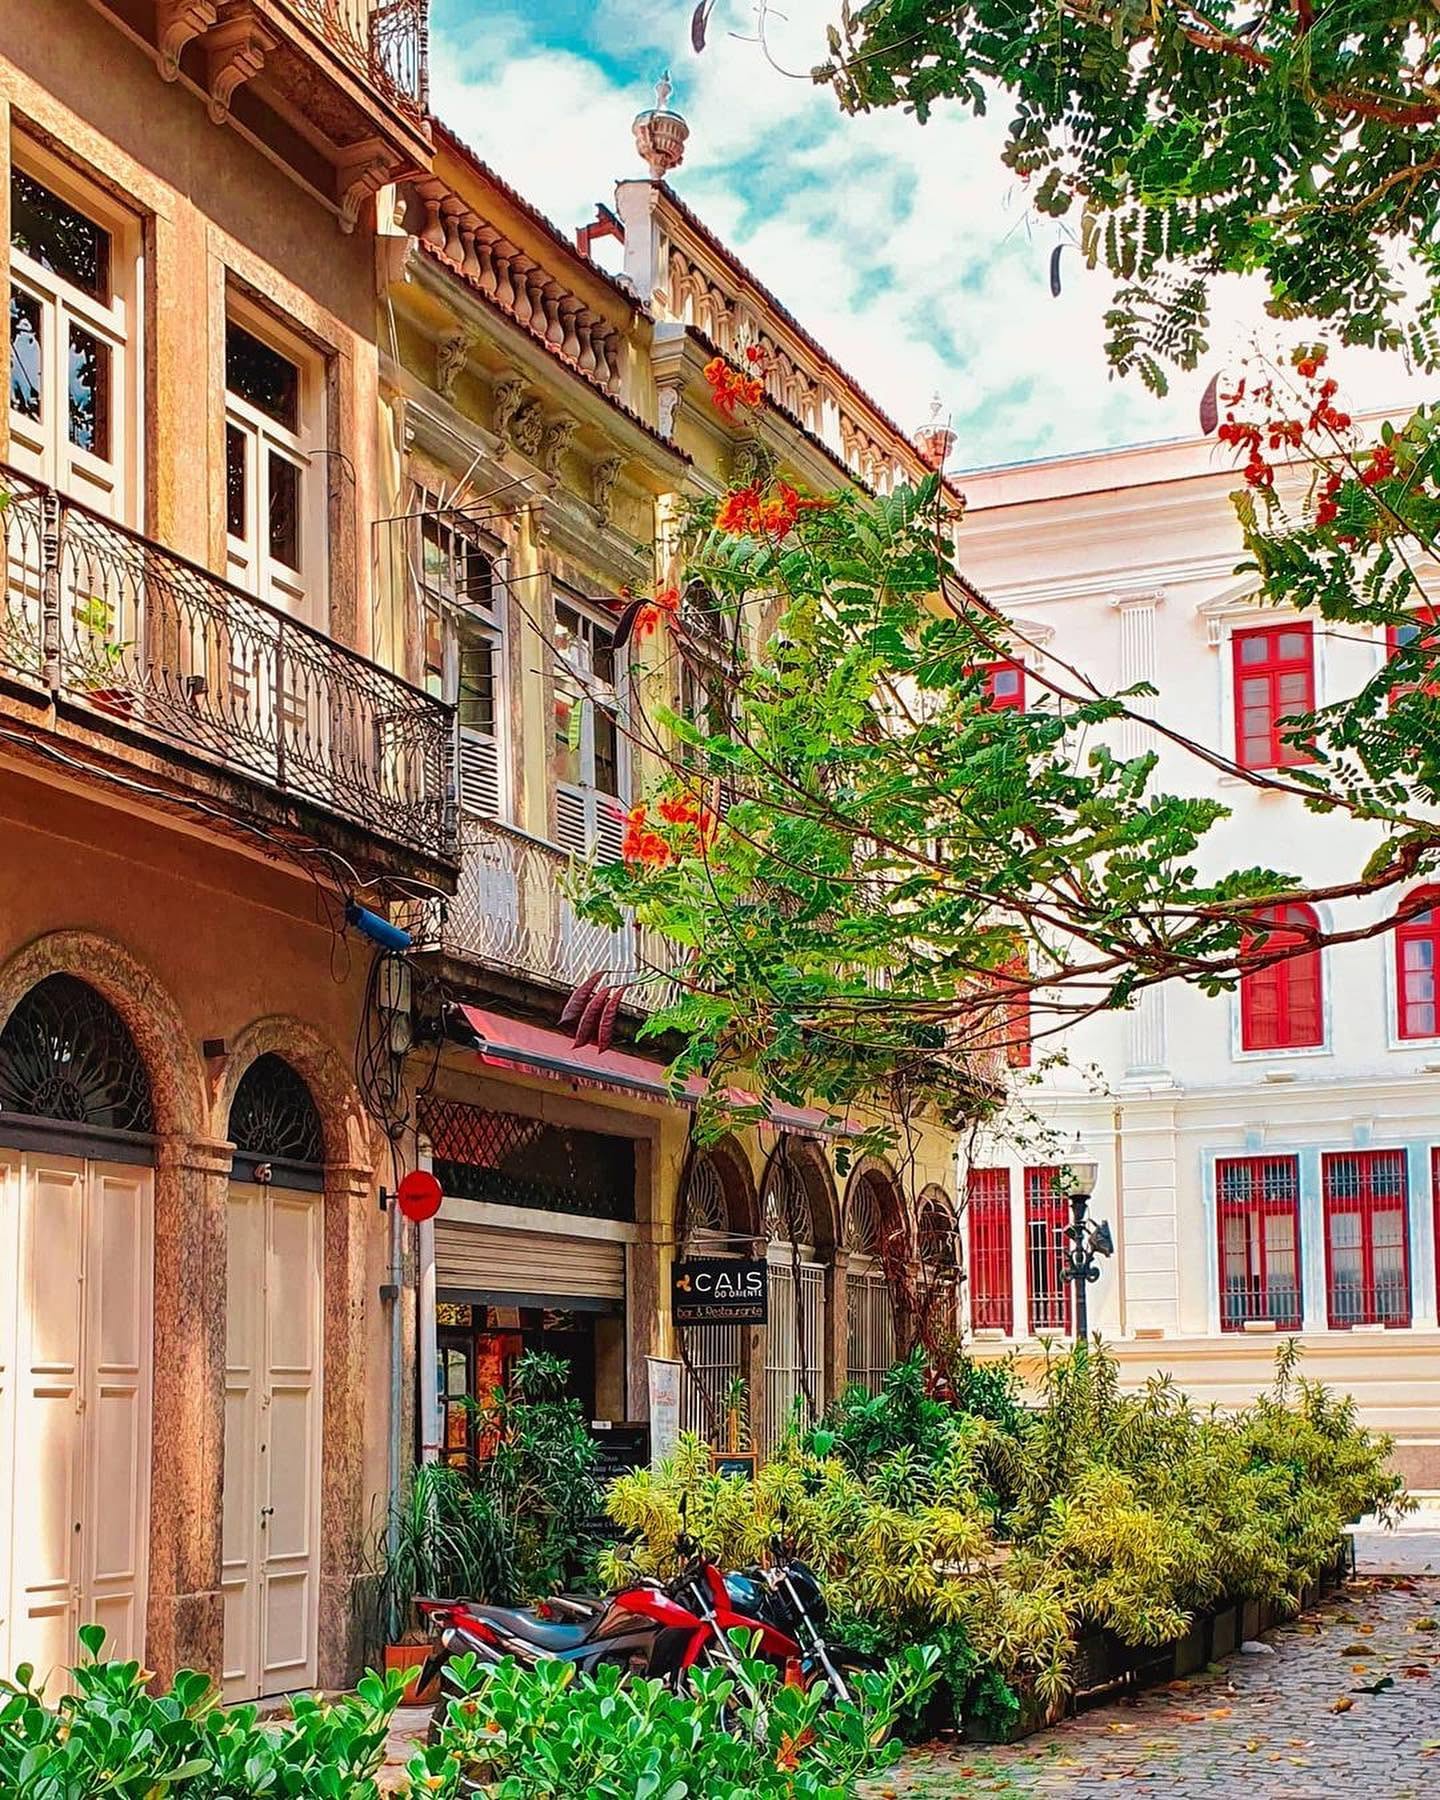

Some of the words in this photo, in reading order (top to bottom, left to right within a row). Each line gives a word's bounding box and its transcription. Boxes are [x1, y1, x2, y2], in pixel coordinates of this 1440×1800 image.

[695, 1271, 763, 1292] CAIS
[714, 1289, 727, 1298] DO
[728, 1289, 763, 1298] ORIENTE
